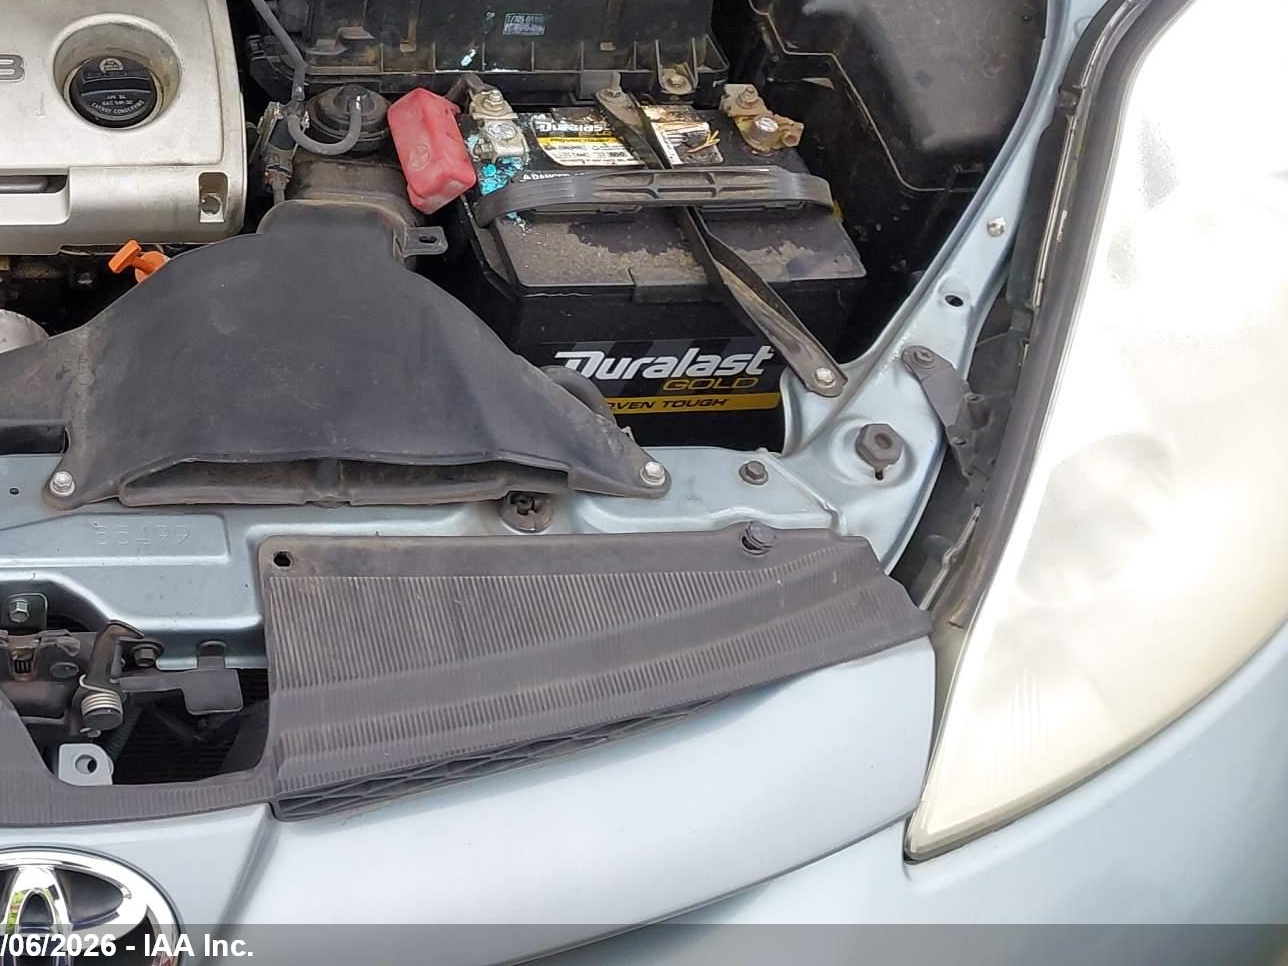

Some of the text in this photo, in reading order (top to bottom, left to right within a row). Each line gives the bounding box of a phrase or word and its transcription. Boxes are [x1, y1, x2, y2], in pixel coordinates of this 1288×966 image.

[554, 345, 775, 381] Duralast
[661, 377, 759, 392] GOLD
[607, 397, 728, 410] OVEN TOUGH
